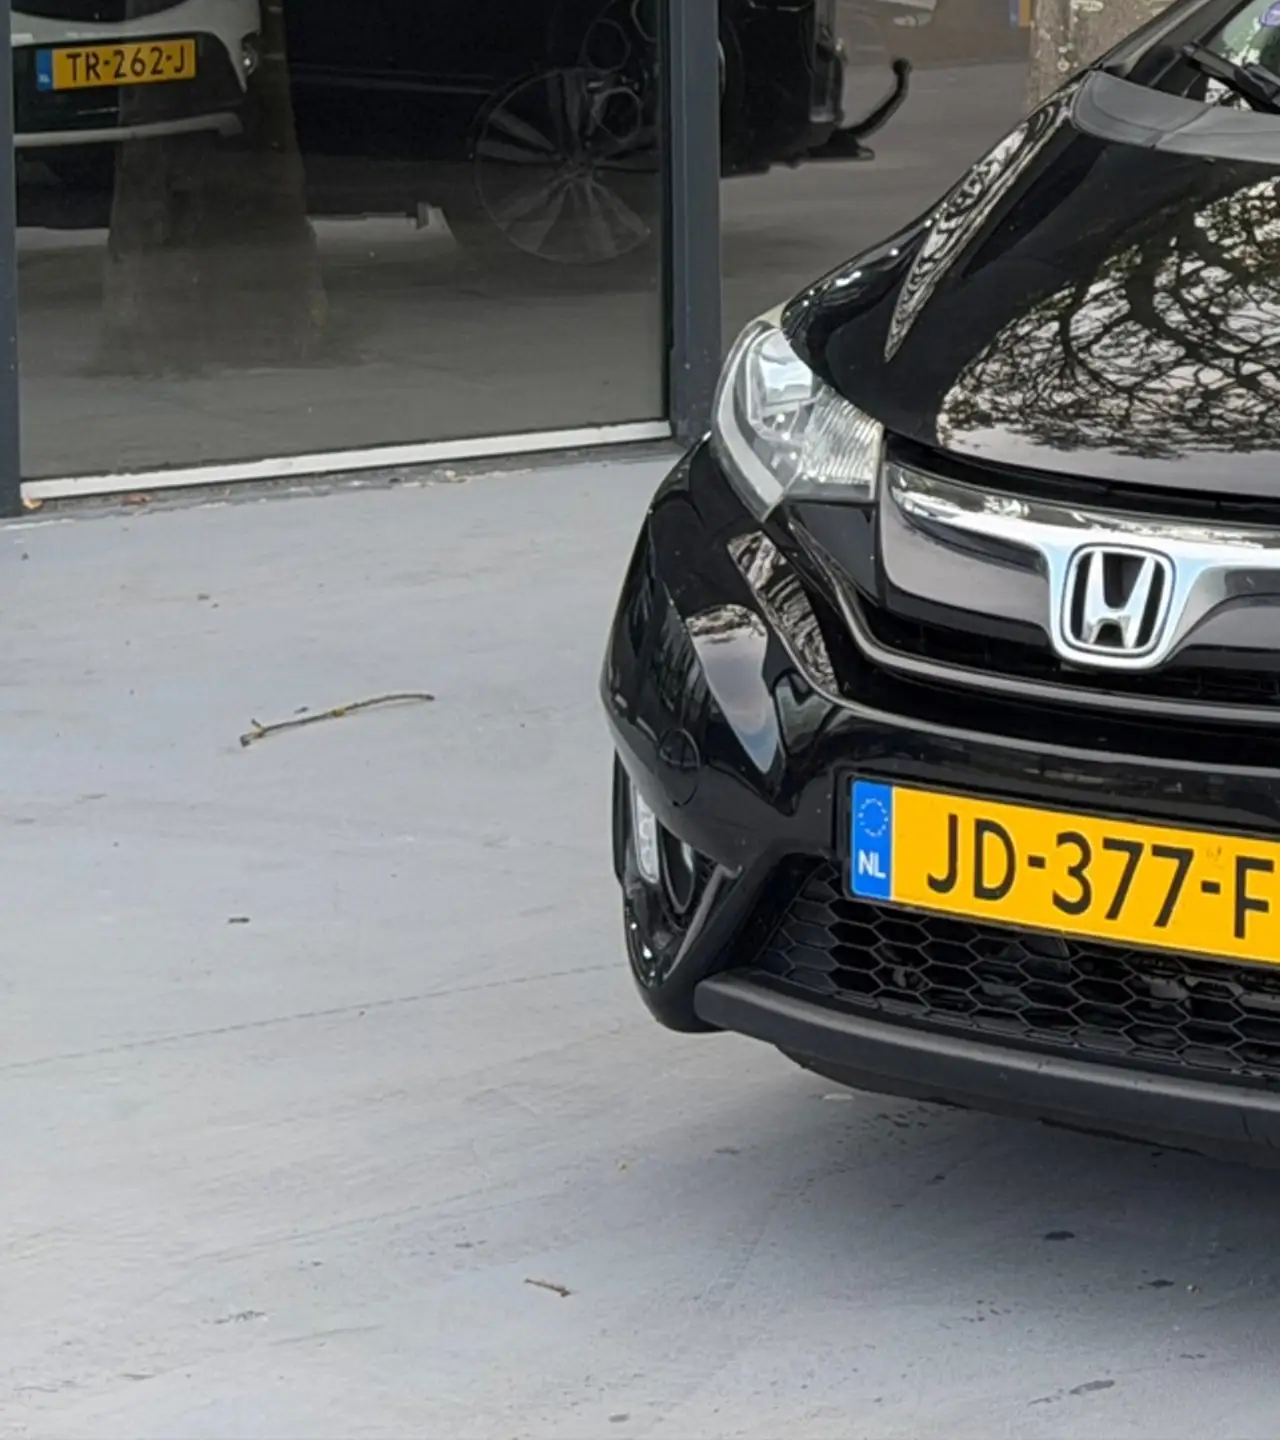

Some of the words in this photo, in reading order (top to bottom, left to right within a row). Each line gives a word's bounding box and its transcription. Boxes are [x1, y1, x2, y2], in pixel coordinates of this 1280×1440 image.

[66, 45, 185, 81] TR-262-J
[857, 850, 887, 879] NL
[926, 812, 1276, 940] JD-377-F
